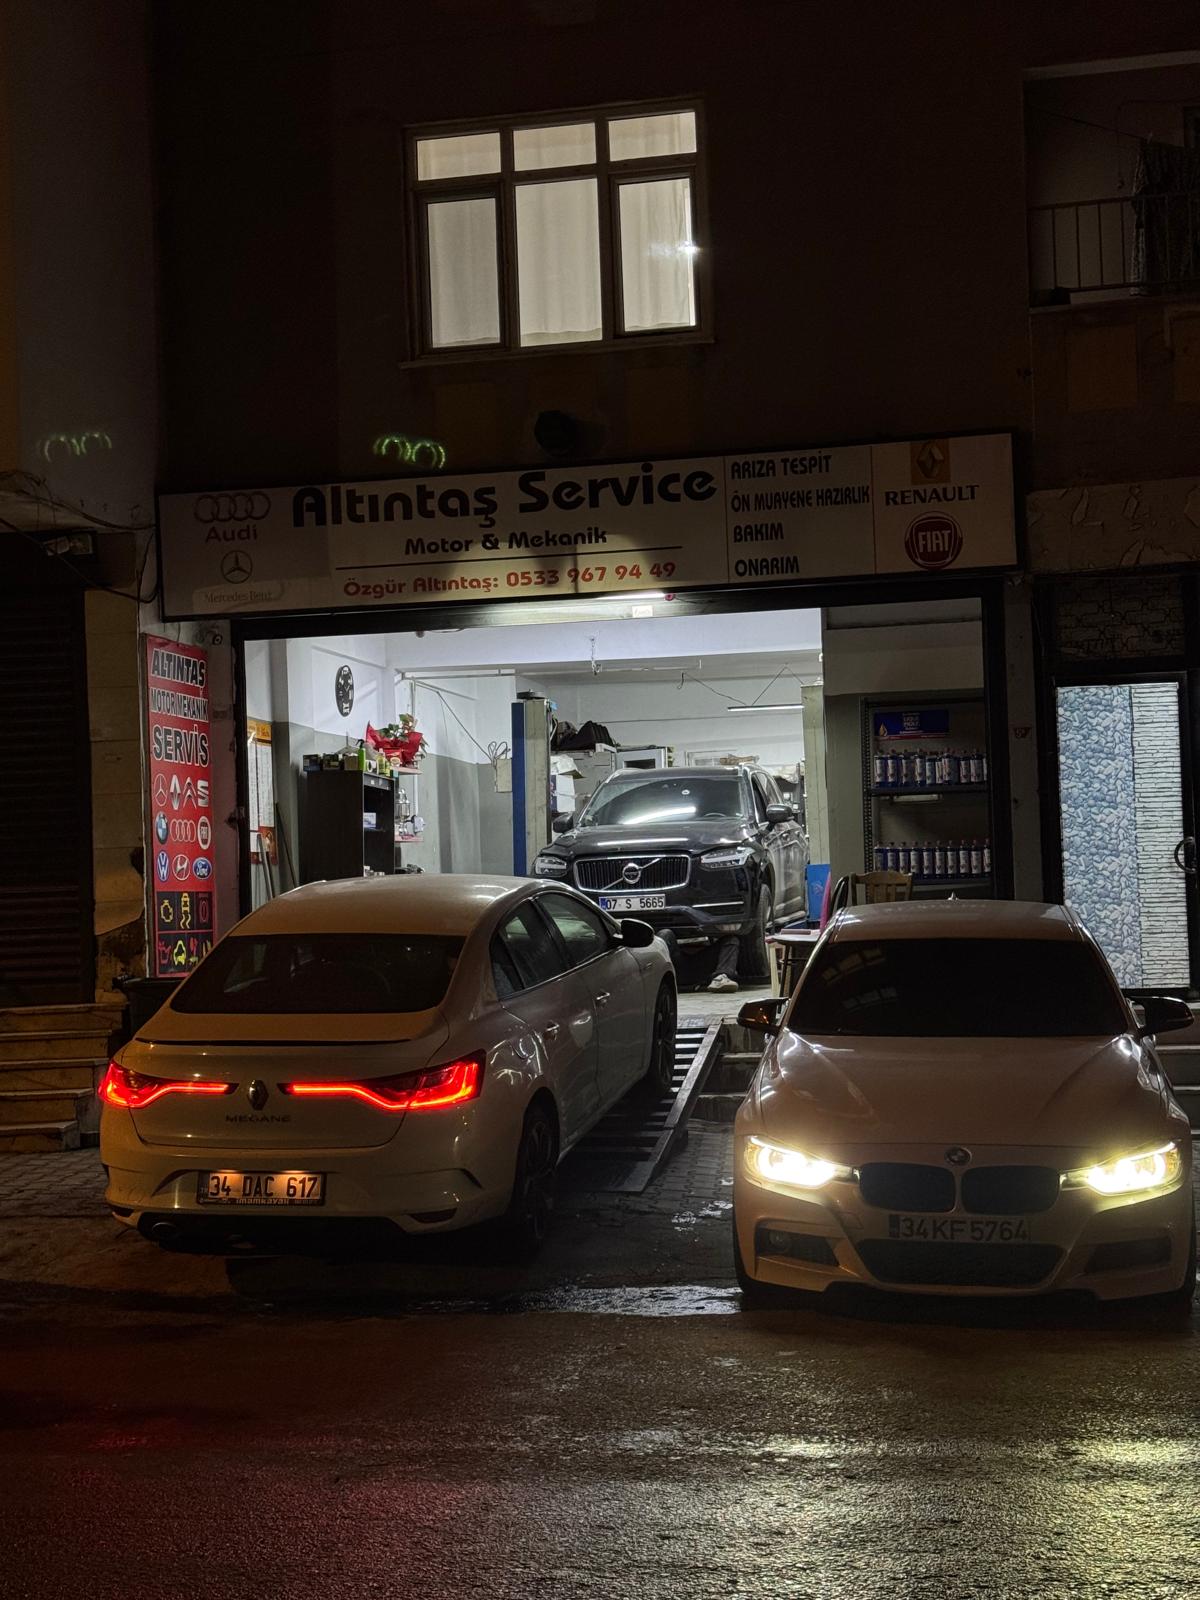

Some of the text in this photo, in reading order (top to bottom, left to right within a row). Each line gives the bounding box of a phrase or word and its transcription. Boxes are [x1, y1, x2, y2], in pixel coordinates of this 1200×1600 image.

[731, 450, 832, 480] ARIZA TESPİT
[293, 463, 718, 529] Altıntaş Service
[731, 485, 871, 513] ÖN MUAYENE HAZIRLIK
[884, 485, 979, 506] RENAULT
[206, 524, 258, 543] Audi
[405, 526, 608, 556] Motor & Mekanik
[733, 522, 785, 543] BAKIM
[917, 529, 952, 553] FIAT
[735, 556, 800, 577] ONARIM
[343, 577, 406, 599] Özgür
[506, 571, 560, 587] 0533
[567, 567, 607, 583] 967
[615, 564, 643, 580] 94
[649, 562, 677, 578] 49
[150, 687, 177, 716] MOTOR
[153, 724, 209, 768] SERVİS
[606, 897, 664, 910] 07 S 5665
[225, 1114, 291, 1123] MEGANE
[210, 1175, 318, 1198] 34 DAC 617
